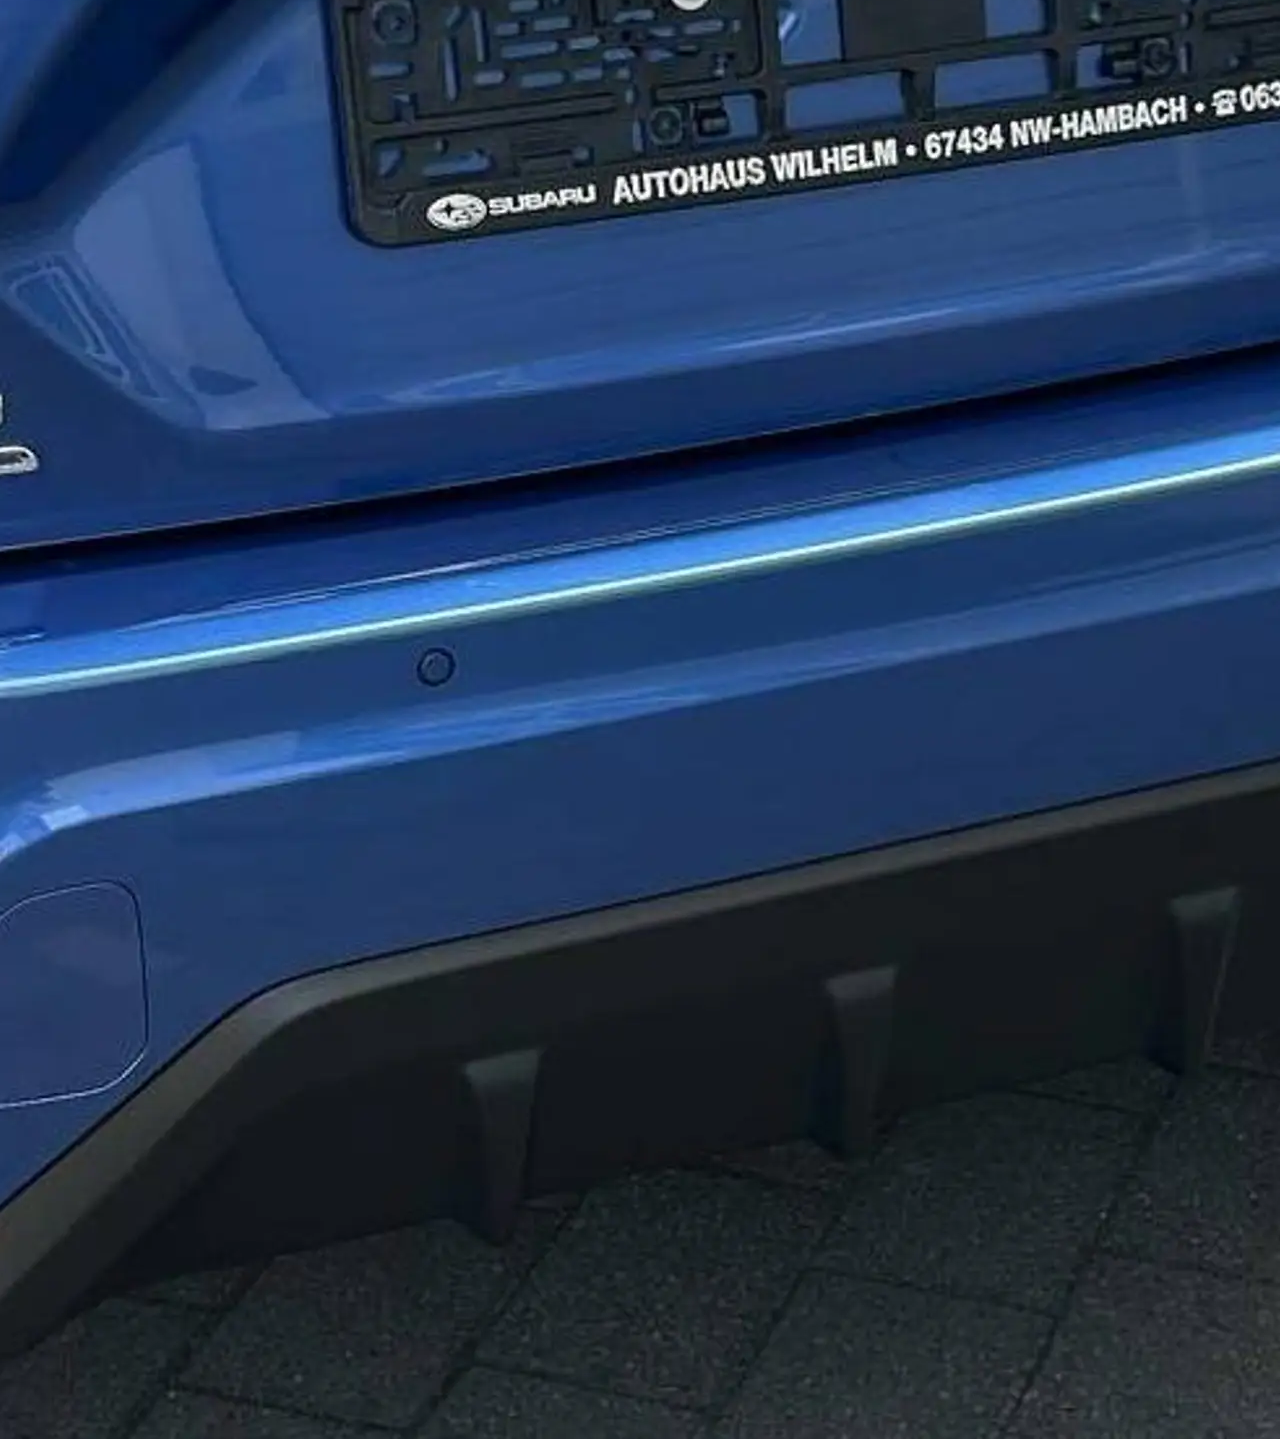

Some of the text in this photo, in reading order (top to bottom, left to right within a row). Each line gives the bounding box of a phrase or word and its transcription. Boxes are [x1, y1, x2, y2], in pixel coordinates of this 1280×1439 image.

[487, 183, 597, 216] SUBARU
[612, 160, 766, 205] AUTOHAUS
[770, 138, 898, 183] WILHELM
[924, 123, 1005, 161] 67434
[1009, 94, 1189, 149] NW-HAMBACH
